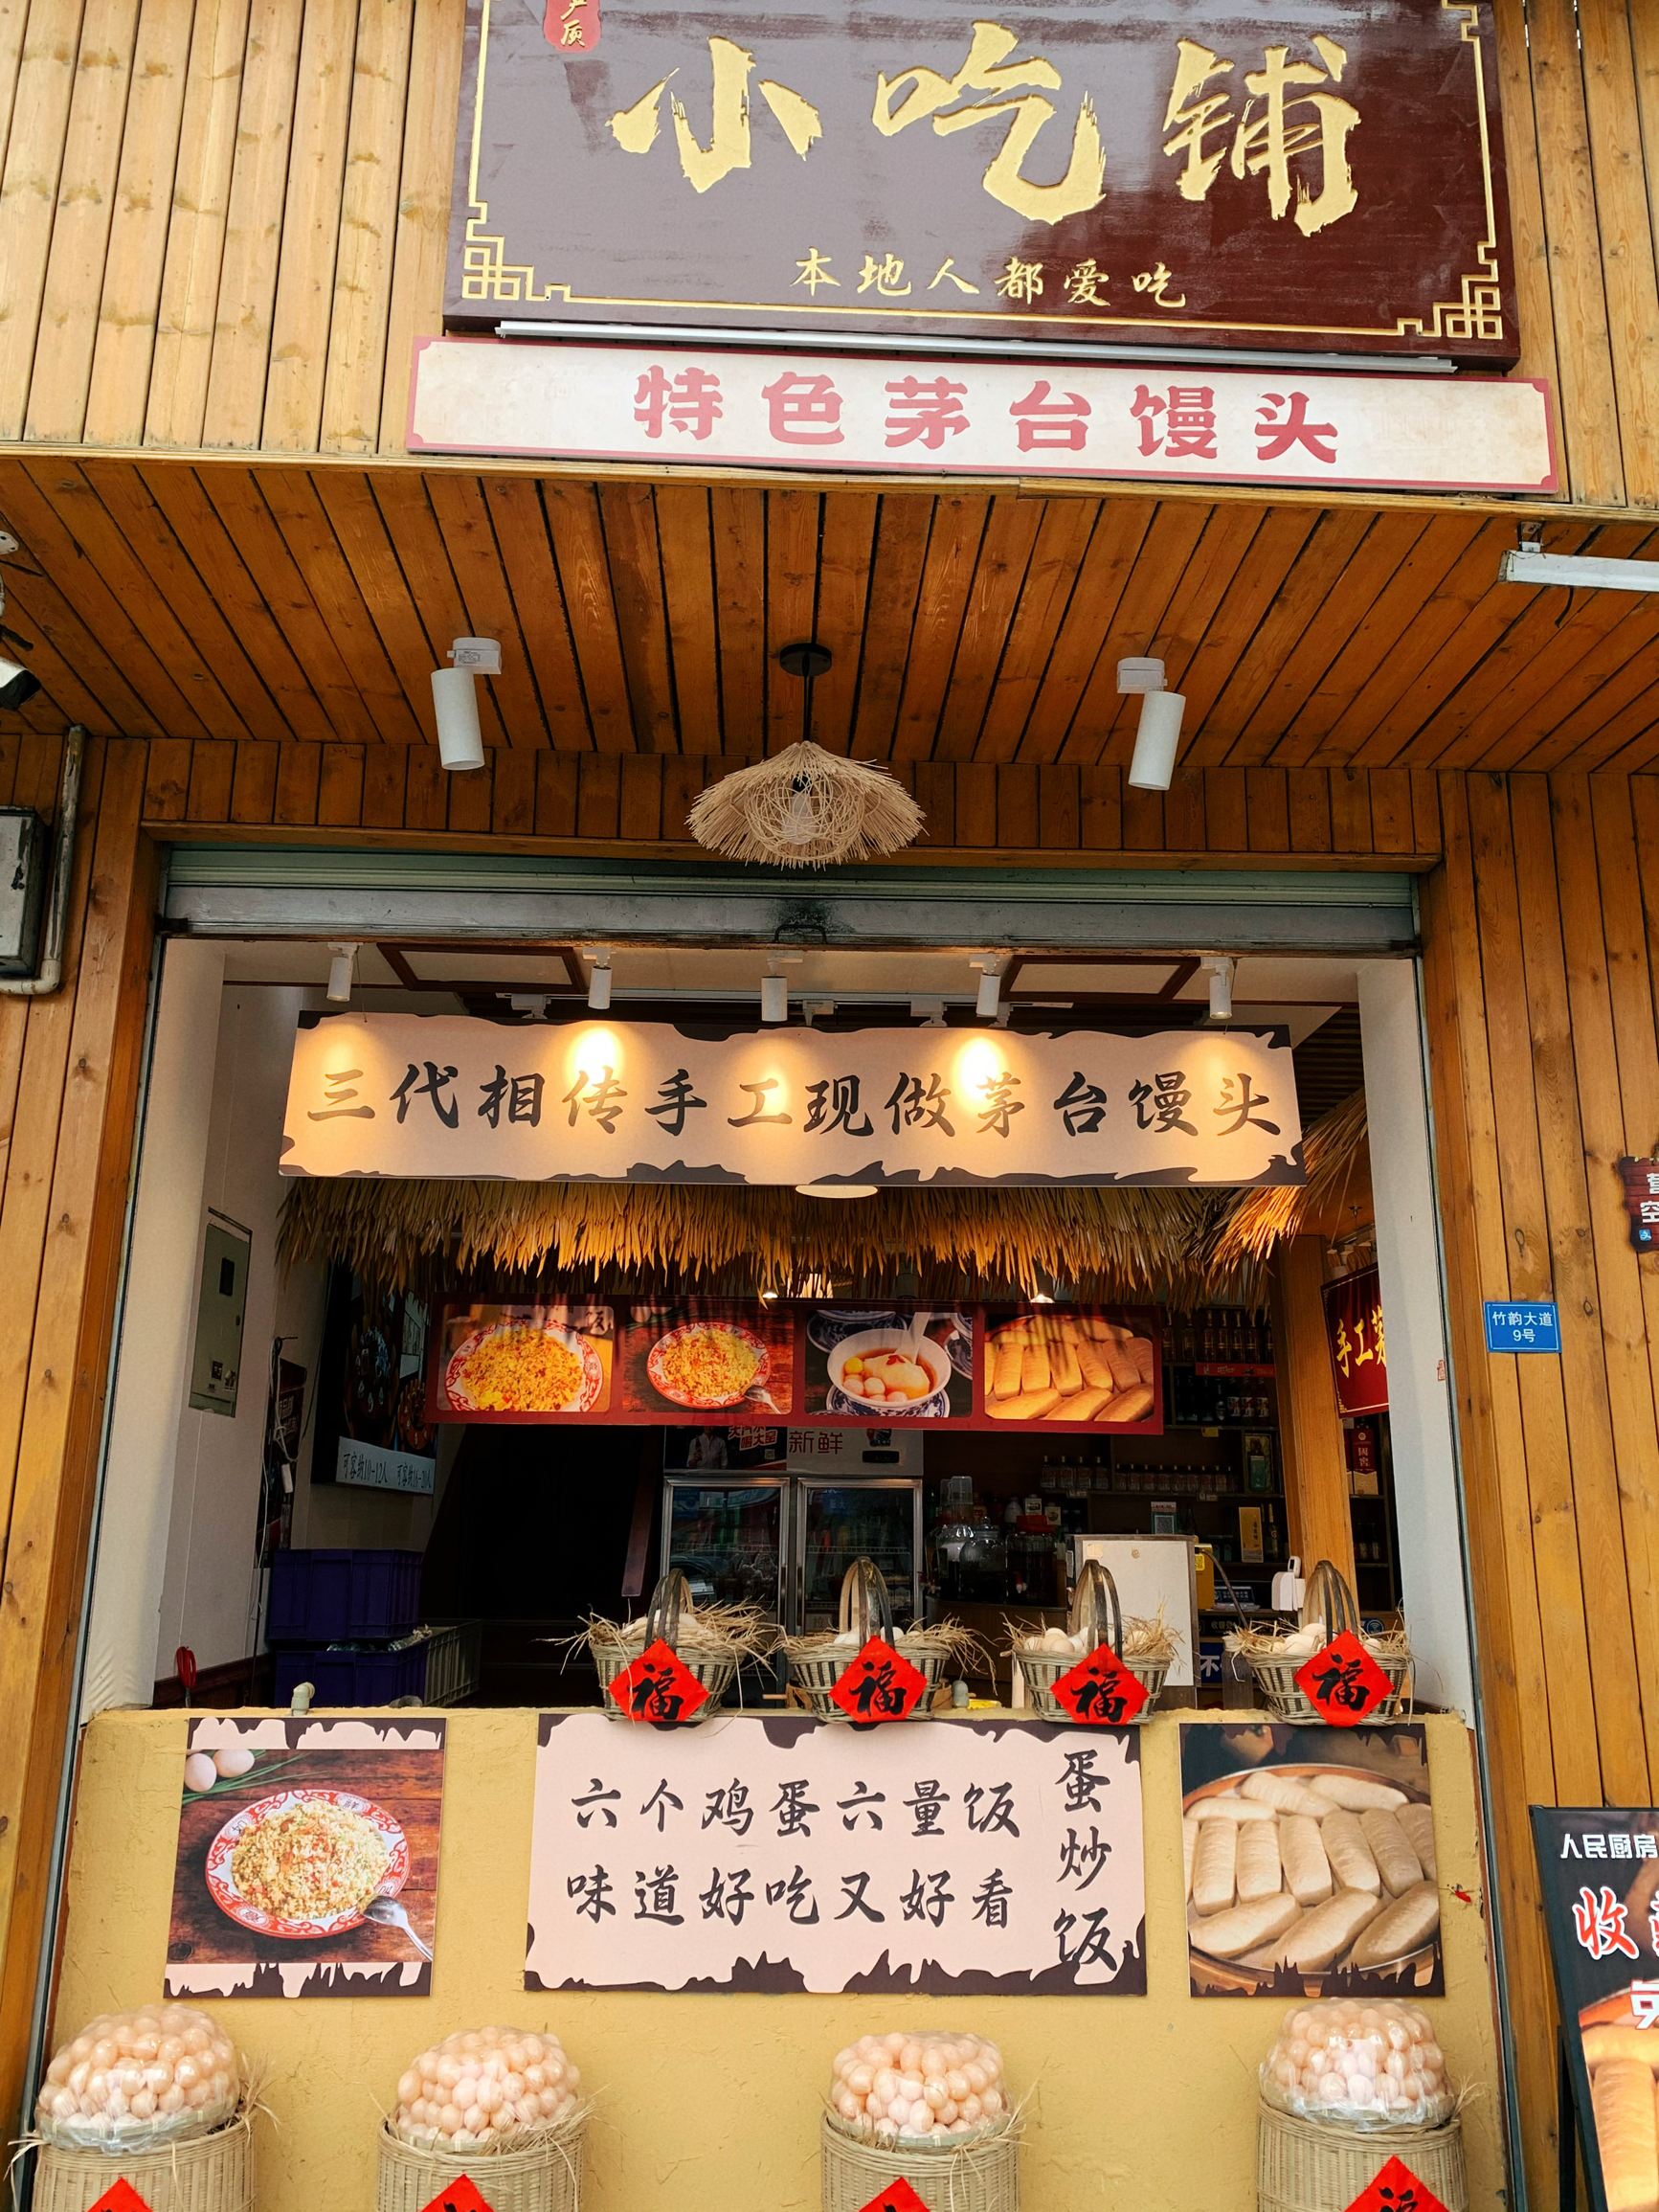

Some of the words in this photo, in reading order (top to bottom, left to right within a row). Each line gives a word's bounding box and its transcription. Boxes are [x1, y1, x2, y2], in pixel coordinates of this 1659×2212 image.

[605, 19, 1361, 237] 小吃铺
[790, 246, 1187, 308] 本地人都爱吃
[633, 364, 1339, 464] 特色茅台馒头
[307, 1061, 1282, 1137] 三代相传手工现做茅台馒头
[1491, 1311, 1554, 1327] 竹韵大道
[1513, 1329, 1536, 1343] 9号
[789, 1430, 843, 1455] 新鲜
[627, 1662, 685, 1721] 福
[848, 1659, 908, 1716] 福
[1070, 1666, 1129, 1723] 福
[1199, 1655, 1222, 1678] 不
[1312, 1653, 1371, 1711] 福
[572, 1777, 1020, 1838] 六个鸡蛋六量饭
[1052, 1749, 1118, 1973] 蛋炒饭
[1560, 1833, 1659, 1859] 人民厨房
[567, 1864, 1014, 1930] 味道好吃又好看
[1572, 1885, 1659, 1961] 收
